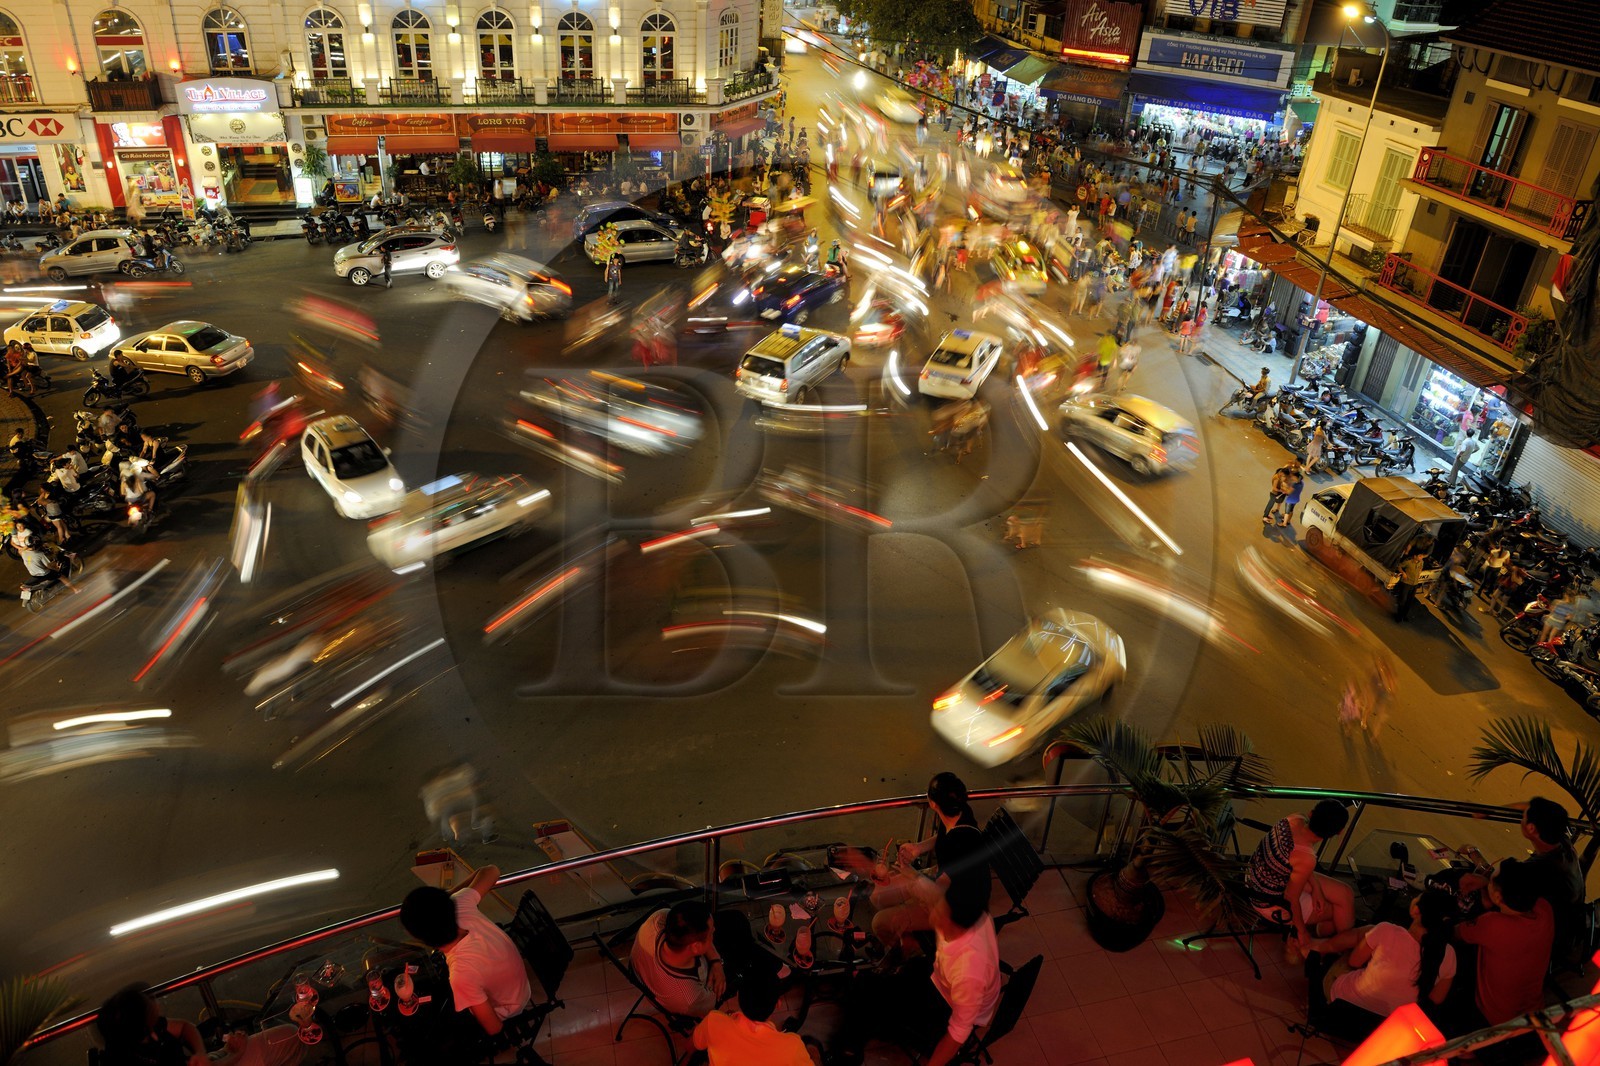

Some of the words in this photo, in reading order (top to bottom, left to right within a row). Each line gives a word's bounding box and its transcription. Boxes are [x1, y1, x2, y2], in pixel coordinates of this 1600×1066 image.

[1081, 2, 1107, 27] Air
[1090, 16, 1121, 40] Asia
[1181, 51, 1246, 75] HAFASCO
[218, 86, 266, 100] VILLAGE
[1057, 93, 1067, 101] 104
[1067, 94, 1086, 103] HÀNG
[1086, 96, 1102, 105] ĐÀO
[1173, 101, 1201, 111] TRANG
[1219, 107, 1242, 117] HÀNG
[1245, 110, 1264, 119] ĐÀO
[351, 118, 374, 127] Coffee
[131, 126, 163, 137] KFC
